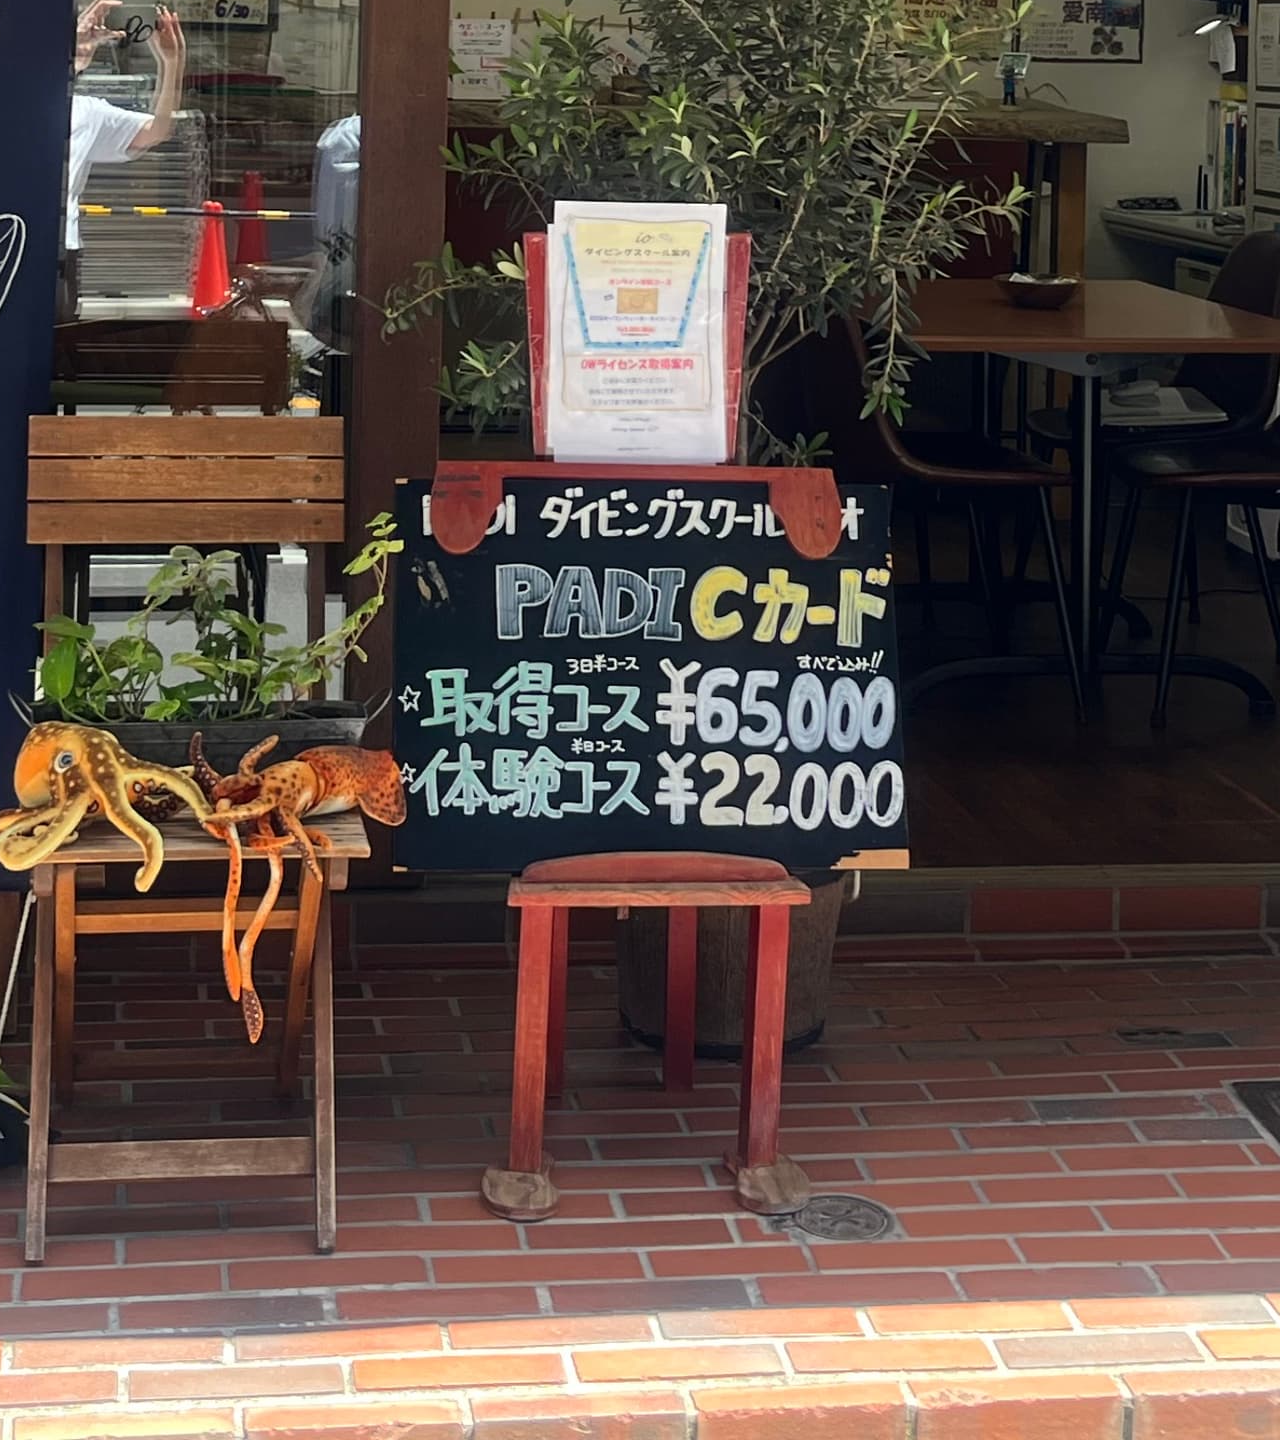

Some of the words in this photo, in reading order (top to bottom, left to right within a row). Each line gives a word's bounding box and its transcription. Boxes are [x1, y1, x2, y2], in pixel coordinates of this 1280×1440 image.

[585, 248, 691, 258] ダイビングスクール案内
[539, 487, 786, 539] ダイビングスクール
[496, 563, 685, 642] PADI
[689, 565, 892, 648] Cカード
[420, 661, 649, 738] 取得コース
[655, 658, 895, 753] ¥65,000
[570, 737, 626, 754] 半日コース
[410, 743, 649, 818] 体験コース
